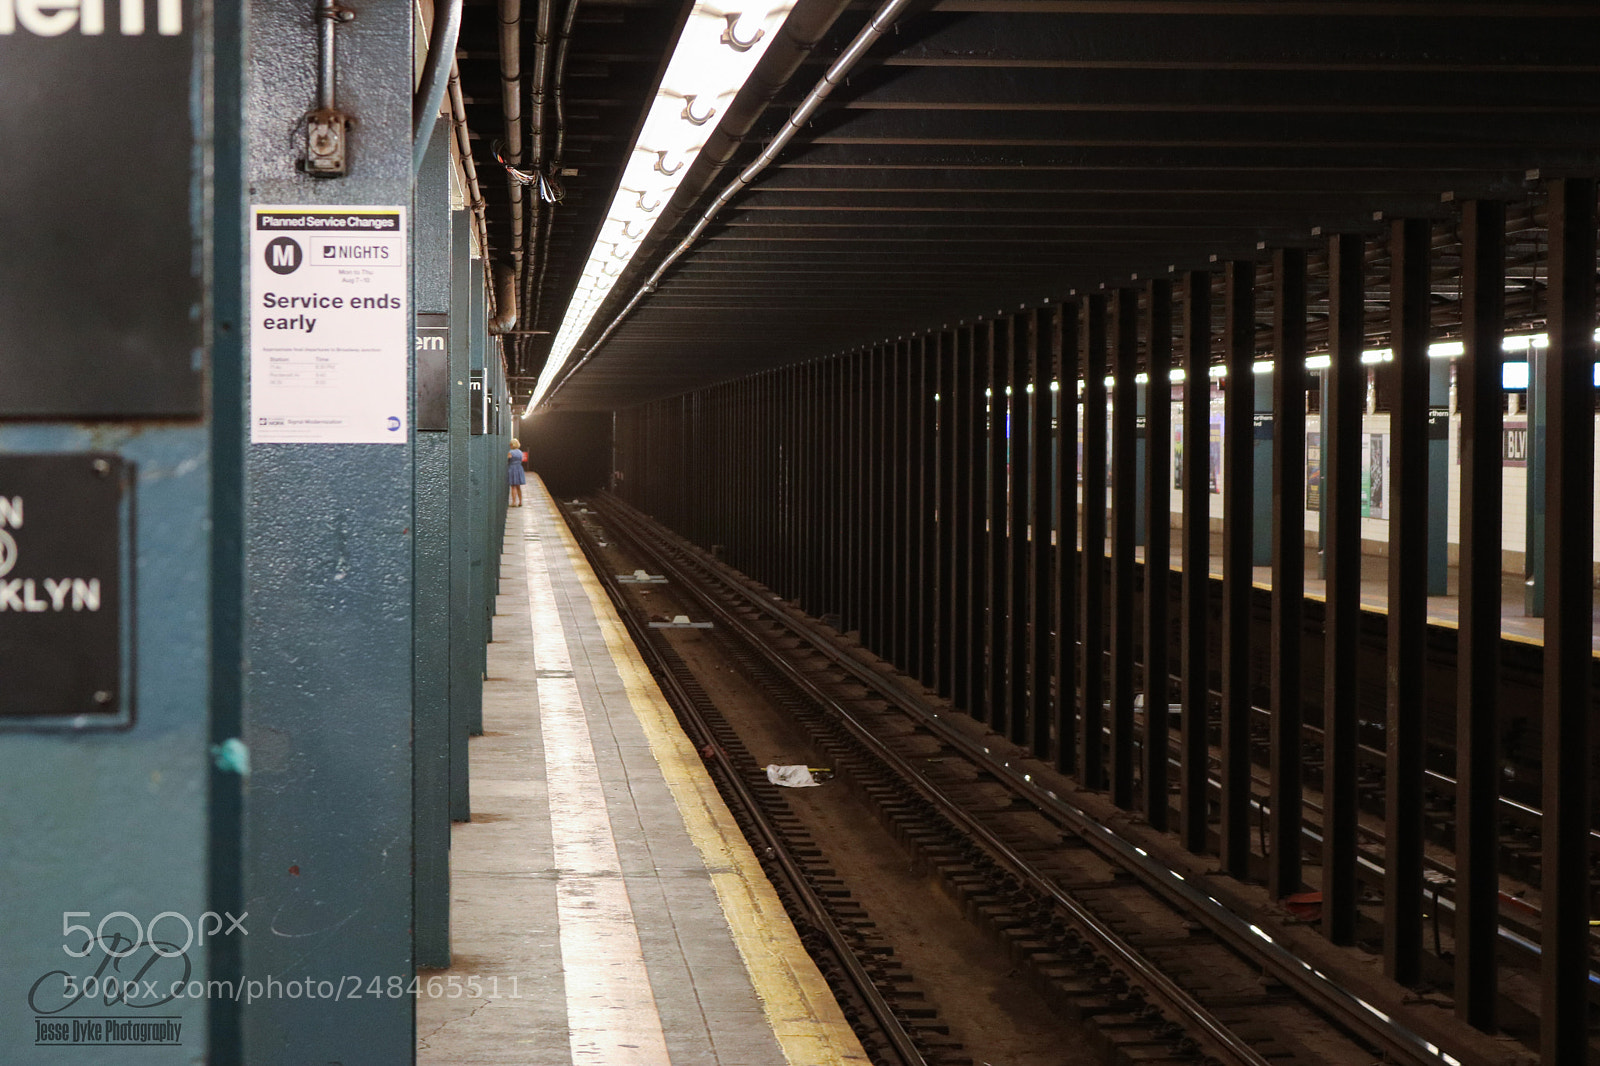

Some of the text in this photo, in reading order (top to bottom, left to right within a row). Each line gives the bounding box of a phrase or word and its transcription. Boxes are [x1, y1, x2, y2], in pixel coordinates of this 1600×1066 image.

[262, 216, 394, 229] Planned Service Changes
[272, 245, 294, 266] M
[339, 246, 389, 258] NIGHTS
[263, 292, 401, 309] Service ends
[263, 314, 317, 333] early
[1508, 430, 1527, 459] BLV
